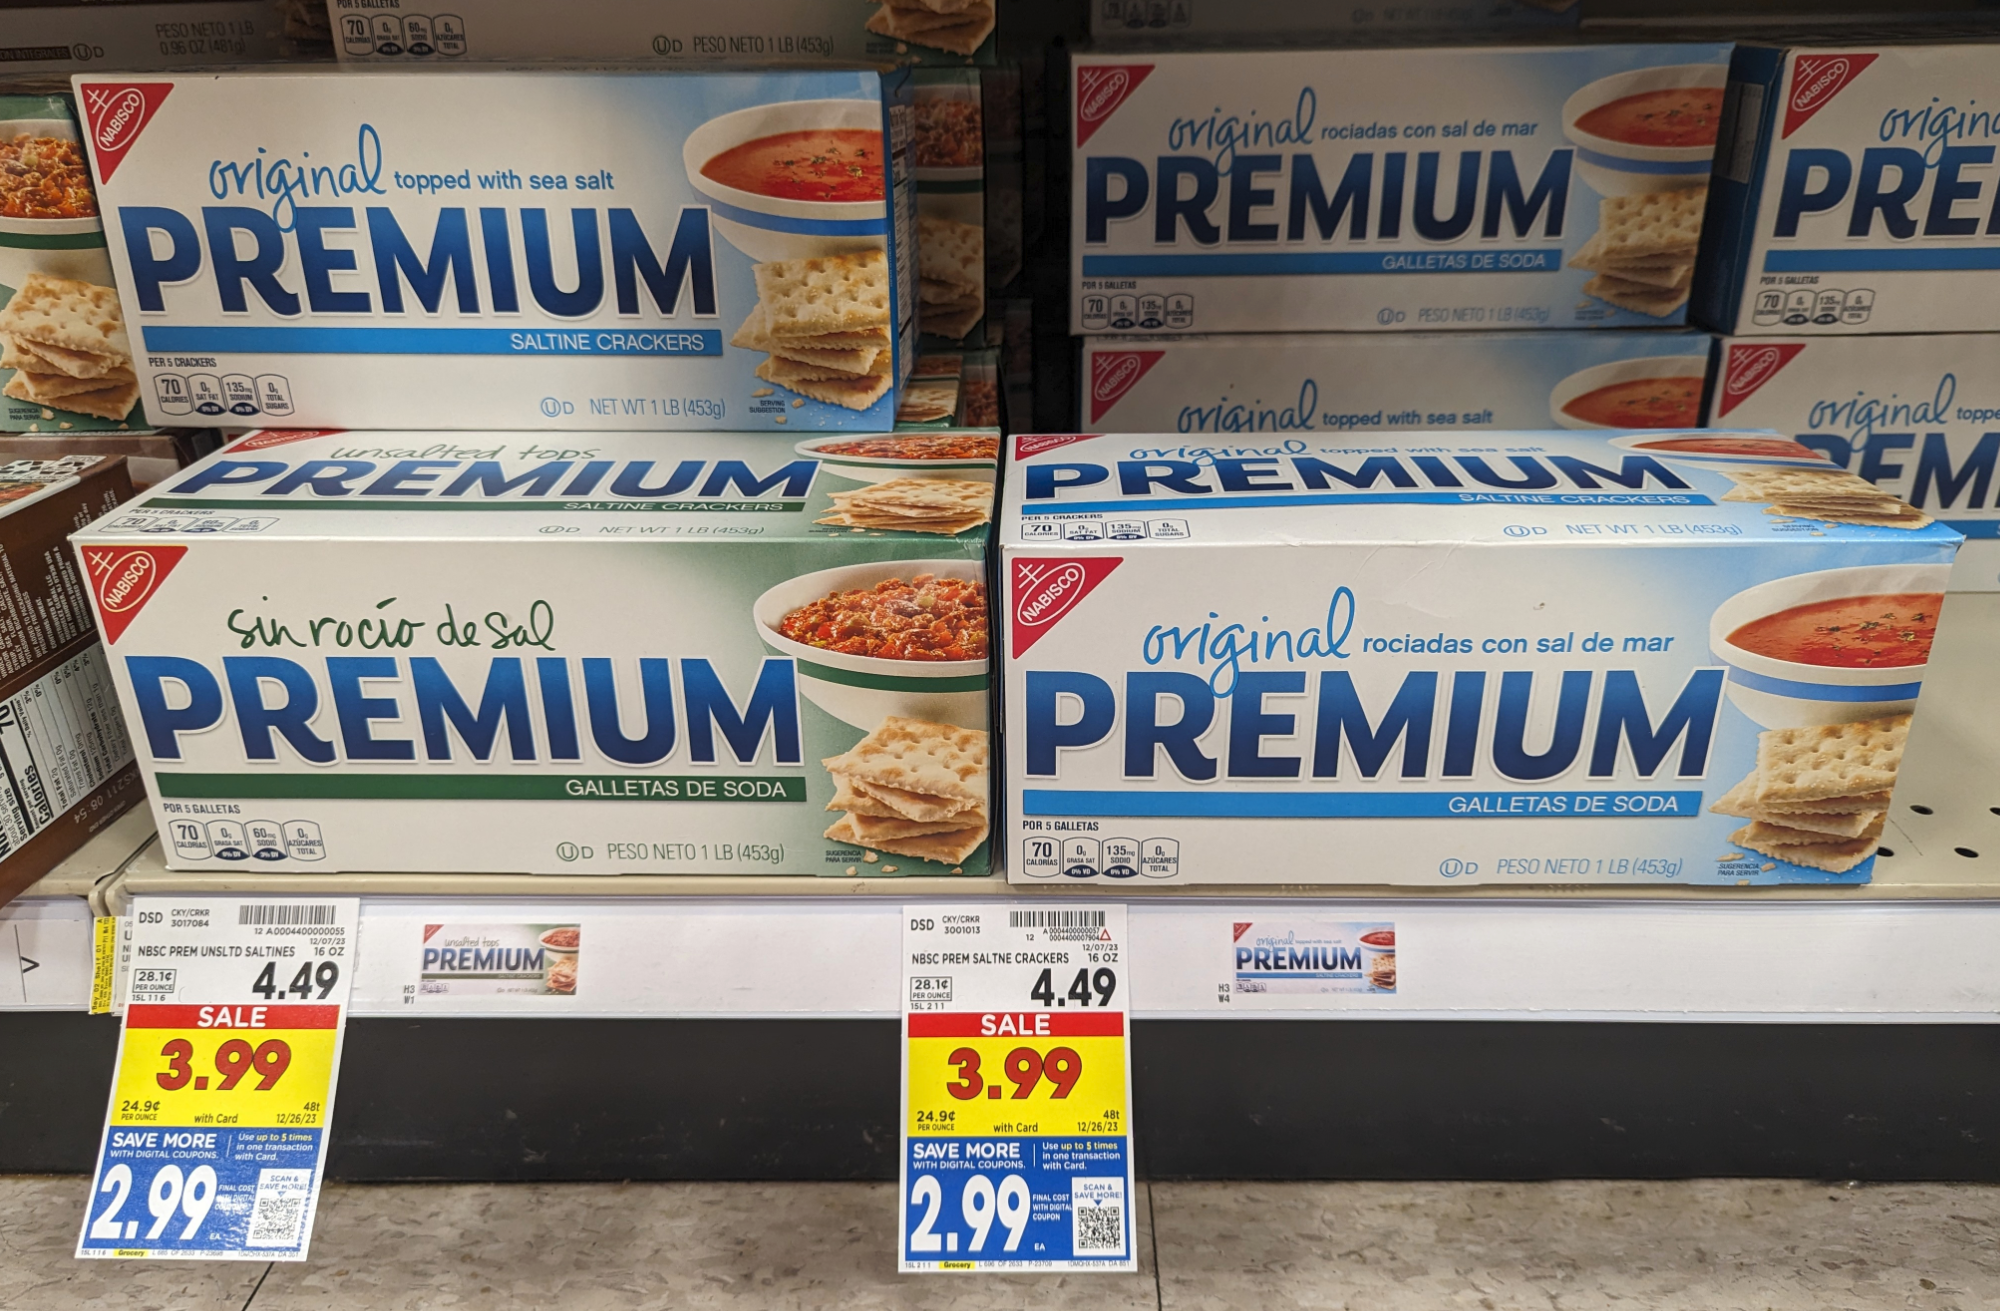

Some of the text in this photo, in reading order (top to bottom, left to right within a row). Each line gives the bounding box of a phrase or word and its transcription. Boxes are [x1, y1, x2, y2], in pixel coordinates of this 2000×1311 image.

[694, 36, 834, 56] PESO NETO 1 LB (453g)
[1796, 60, 1846, 108] NABISCO
[1083, 71, 1126, 118] NABISCO
[100, 93, 140, 148] NABISCO
[1169, 87, 1538, 177] original rociadas con sal de mar
[209, 123, 614, 233] original topped with sea salt
[1086, 150, 1573, 244] PREMIUM
[118, 206, 718, 317] PREMIUM
[1382, 254, 1546, 270] GALLETAS DE SODA
[511, 333, 704, 351] SALTINE CRACKERS
[1096, 357, 1138, 400] NABISCO
[1730, 350, 1776, 393] NABISCO
[1178, 379, 1318, 433] original
[1808, 373, 1957, 452] original
[330, 444, 601, 461] unsalted tops
[1129, 439, 1307, 467] original
[168, 459, 820, 497] PREMIUM
[1026, 455, 1694, 499] PREMIUM
[563, 502, 784, 512] SALTINE CRACKERS
[1458, 493, 1691, 505] SALTINE CRACKERS
[105, 555, 150, 608] NABISCO
[1022, 567, 1079, 621] NABISCO
[227, 596, 556, 651] sin rocío de sal
[1143, 586, 1674, 698] original rociadas con sal de mar
[125, 655, 802, 766] PREMIUM
[1025, 669, 1727, 783] PREMIUM
[25, 764, 51, 825] Calories
[565, 780, 788, 798] GALLETAS DE SODA
[1448, 796, 1678, 813] GALLETAS DE SODA
[1023, 821, 1099, 831] POR 5 GALLETAS
[607, 842, 785, 863] PESO NETO 1 LB (453g)
[1496, 858, 1682, 877] PESO NETO 1 LB (453g)
[139, 912, 163, 924] DSD
[171, 908, 210, 917] CKY/CRKR
[942, 915, 980, 924] CKY/CRKR
[171, 919, 209, 927] 3017084
[911, 919, 934, 931] DSD
[944, 926, 981, 934] 3001013
[310, 937, 346, 945] 12/07/23
[1082, 943, 1118, 951] 12/07/23
[138, 946, 296, 957] NBSC PREM UNSLTD SALTINES
[314, 947, 345, 956] 16 OZ
[422, 948, 545, 971] PREMIUM
[912, 953, 1069, 964] NBSC PREM SALTNE CRACKERS
[1088, 953, 1118, 962] 16 OZ
[1236, 947, 1362, 970] PREMIUM
[138, 971, 172, 982] 28.1¢
[252, 961, 339, 1000] 4.49
[915, 979, 949, 990] 28.1¢
[1031, 967, 1116, 1007] 4.49
[197, 1006, 268, 1028] SALE
[981, 1013, 1051, 1035] SALE
[156, 1038, 292, 1091] 3.99
[946, 1047, 1082, 1100] 3.99
[121, 1101, 160, 1112] 24.9¢
[1103, 1110, 1120, 1119] 48t
[194, 1114, 239, 1124] with Card
[276, 1113, 317, 1124] 12/26/23
[917, 1111, 955, 1122] 24.9¢
[994, 1123, 1038, 1132] with Card
[1077, 1122, 1118, 1132] 12/26/23
[112, 1132, 217, 1149] SAVE MORE
[1042, 1142, 1117, 1151] Use up to 5 times
[110, 1150, 219, 1160] WITH DIGITAL COUPONS.
[913, 1143, 1020, 1159] SAVE MORE
[1042, 1151, 1050, 1160] in
[1071, 1151, 1120, 1160] transaction
[913, 1160, 1025, 1169] WITH DIGITAL COUPONS.
[1042, 1161, 1087, 1170] with Card.
[89, 1163, 217, 1240] 2.99
[1033, 1203, 1072, 1211] WITH DIGITAL
[911, 1174, 1030, 1252] 2.99
[1033, 1213, 1060, 1221] COUPON
[118, 1250, 145, 1258] Grocery
[1035, 1243, 1045, 1251] EA
[943, 1262, 971, 1270] Grocery
